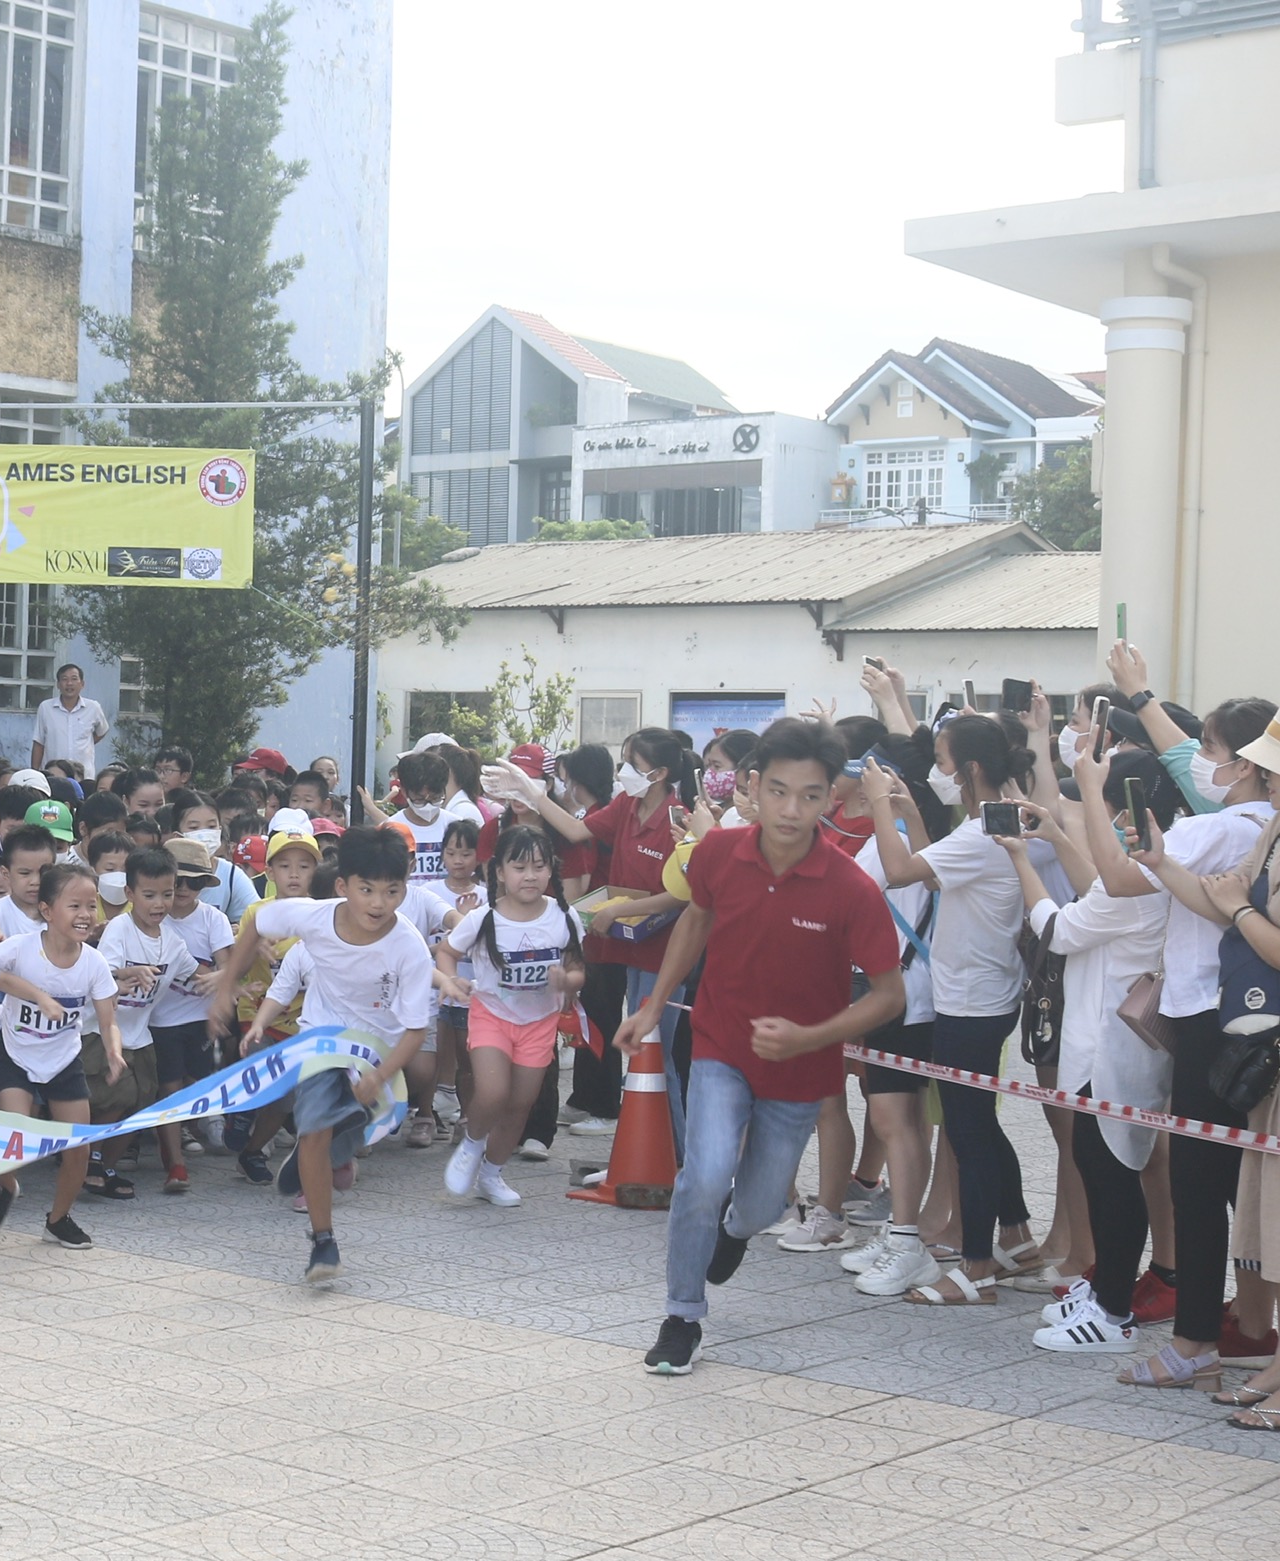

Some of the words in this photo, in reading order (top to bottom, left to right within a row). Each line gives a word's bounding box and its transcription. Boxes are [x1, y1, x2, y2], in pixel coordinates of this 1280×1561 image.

[5, 462, 75, 482] AMES
[81, 464, 187, 485] ENGLISH
[501, 964, 549, 984] B122
